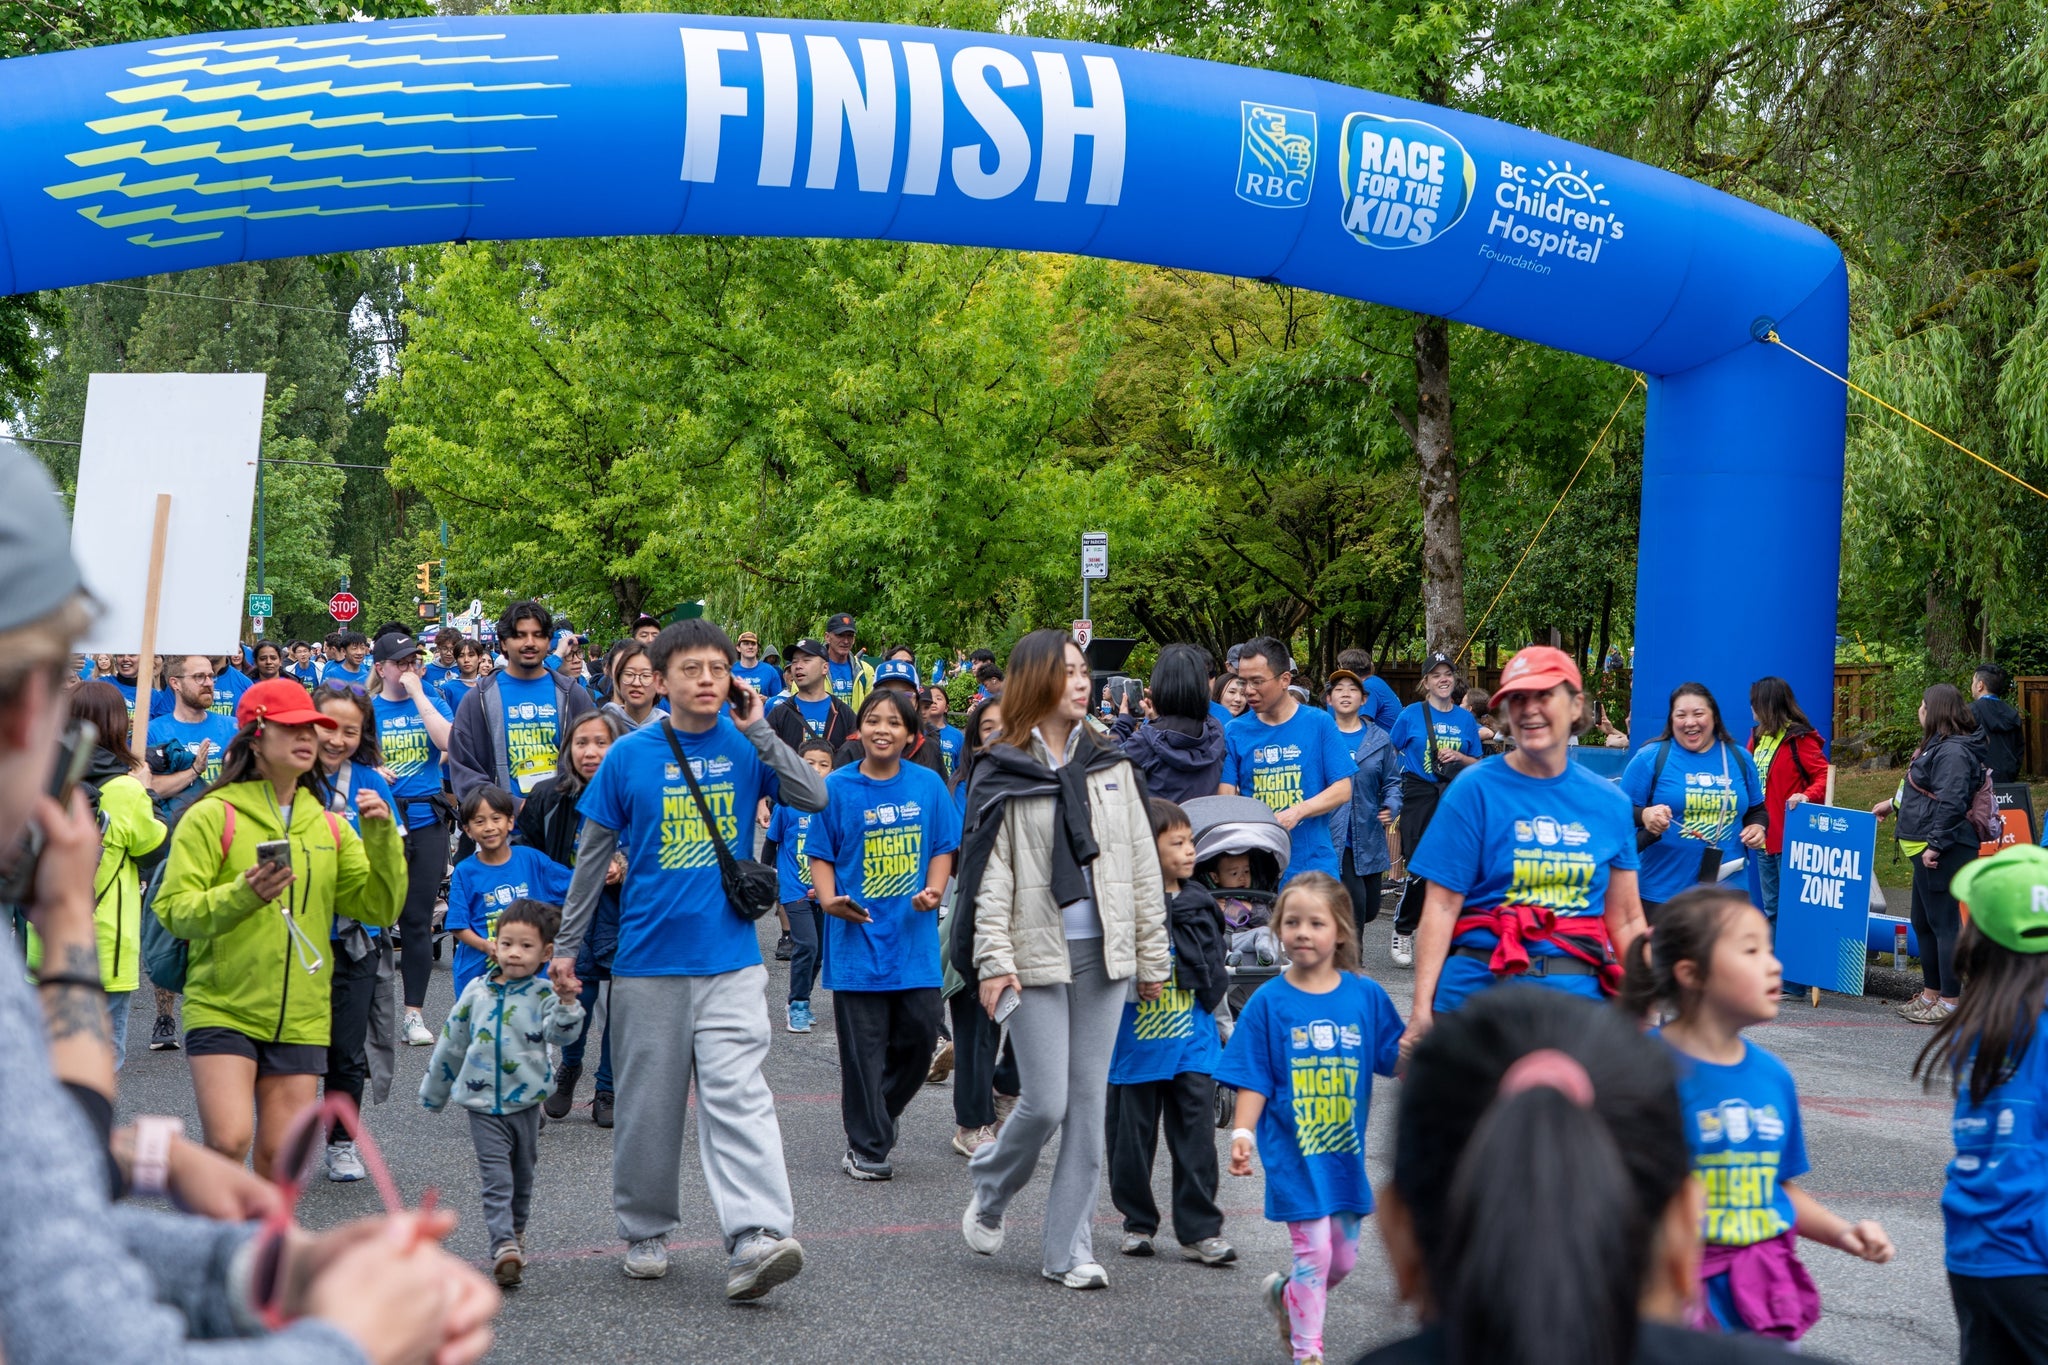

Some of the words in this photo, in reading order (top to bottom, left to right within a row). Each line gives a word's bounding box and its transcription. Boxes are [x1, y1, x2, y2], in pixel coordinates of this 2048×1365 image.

[679, 27, 1126, 206] FINISH
[1361, 131, 1446, 186] RACE
[1500, 161, 1527, 184] BC
[1245, 173, 1304, 202] RBC
[1357, 171, 1402, 199] FOR
[1404, 180, 1442, 208] THE
[1347, 195, 1438, 244] KIDS
[1495, 185, 1624, 240] Children's
[1487, 210, 1605, 264] Hospital
[1478, 244, 1552, 276] Foundation
[331, 601, 357, 613] STOP
[381, 733, 428, 750] MIGHTY
[508, 728, 557, 746] MIGHTY
[380, 747, 429, 764] STRIDES
[663, 785, 687, 795] Small
[711, 781, 734, 791] make
[1253, 771, 1302, 791] MIGHTY
[863, 832, 922, 858] MIGHTY
[863, 853, 920, 878] STRIDE
[1513, 859, 1596, 887] MIGHTY
[1789, 840, 1863, 881] MEDICAL
[1800, 873, 1846, 910] ZONE
[1291, 1055, 1318, 1067] Small
